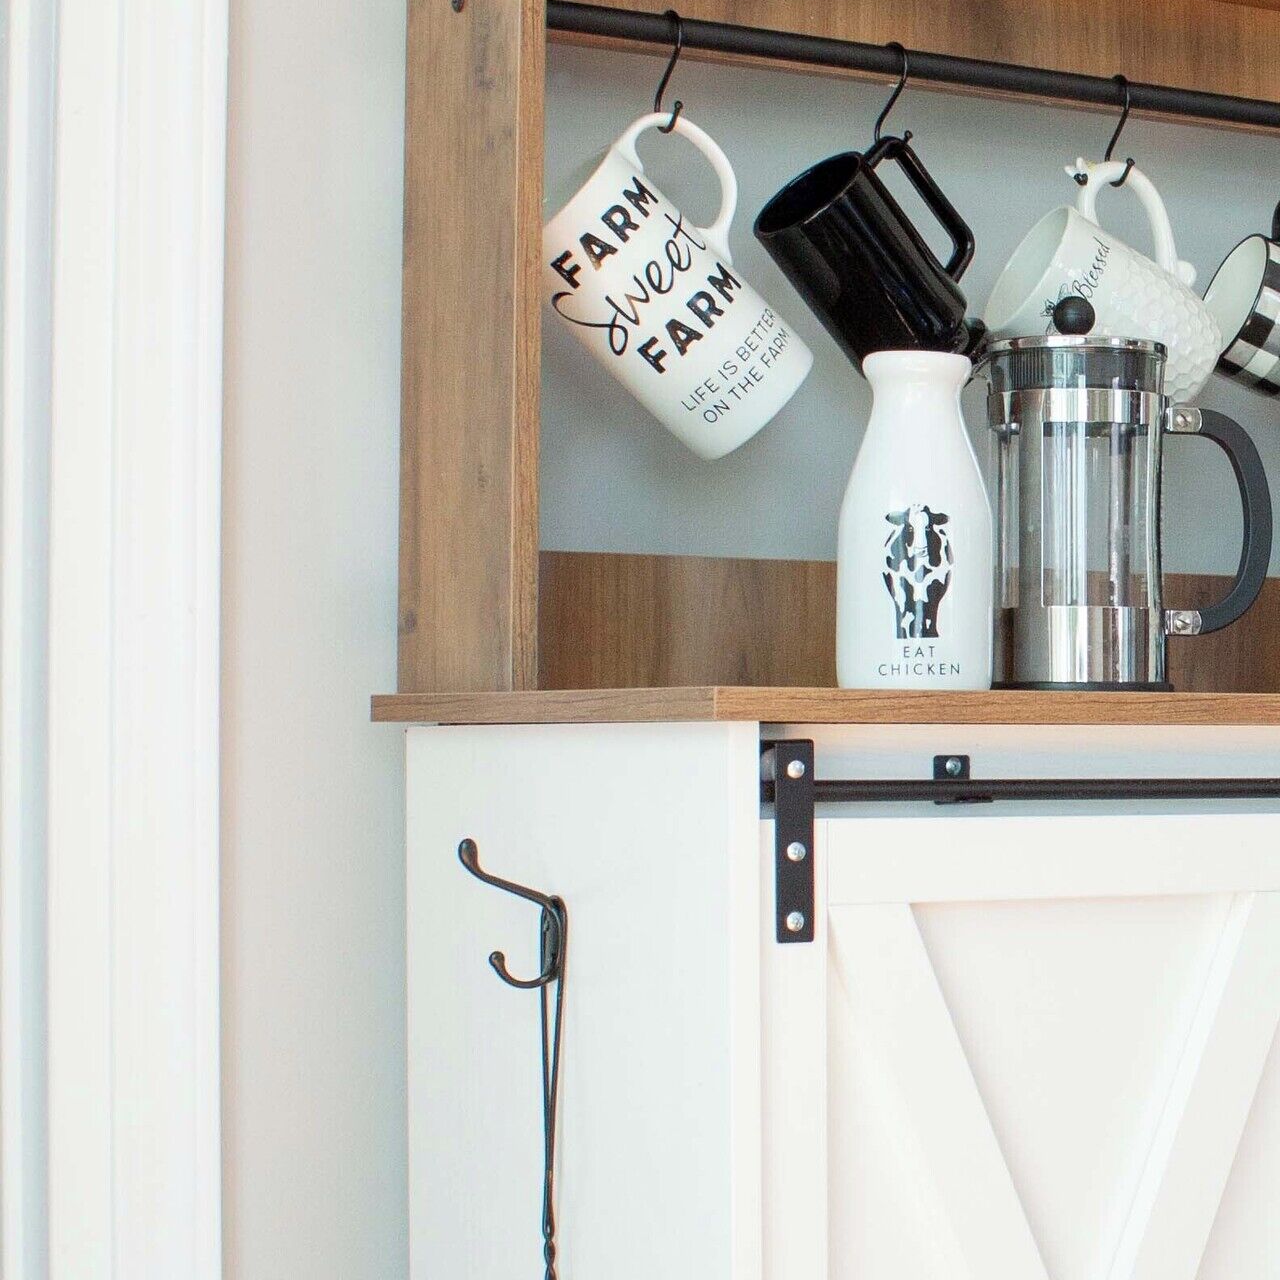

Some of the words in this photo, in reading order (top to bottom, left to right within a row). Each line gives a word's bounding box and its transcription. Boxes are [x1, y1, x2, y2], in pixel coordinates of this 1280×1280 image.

[550, 176, 659, 289] FARM
[1072, 236, 1110, 300] Blessed
[637, 261, 742, 374] FARM
[681, 378, 720, 411] LIFE
[718, 360, 738, 380] IS
[736, 308, 776, 361] BETTER
[703, 399, 730, 423] ON
[728, 366, 764, 400] THE
[760, 327, 790, 368] FARM
[878, 663, 960, 676] CHICKEN
[903, 646, 935, 658] EAT
